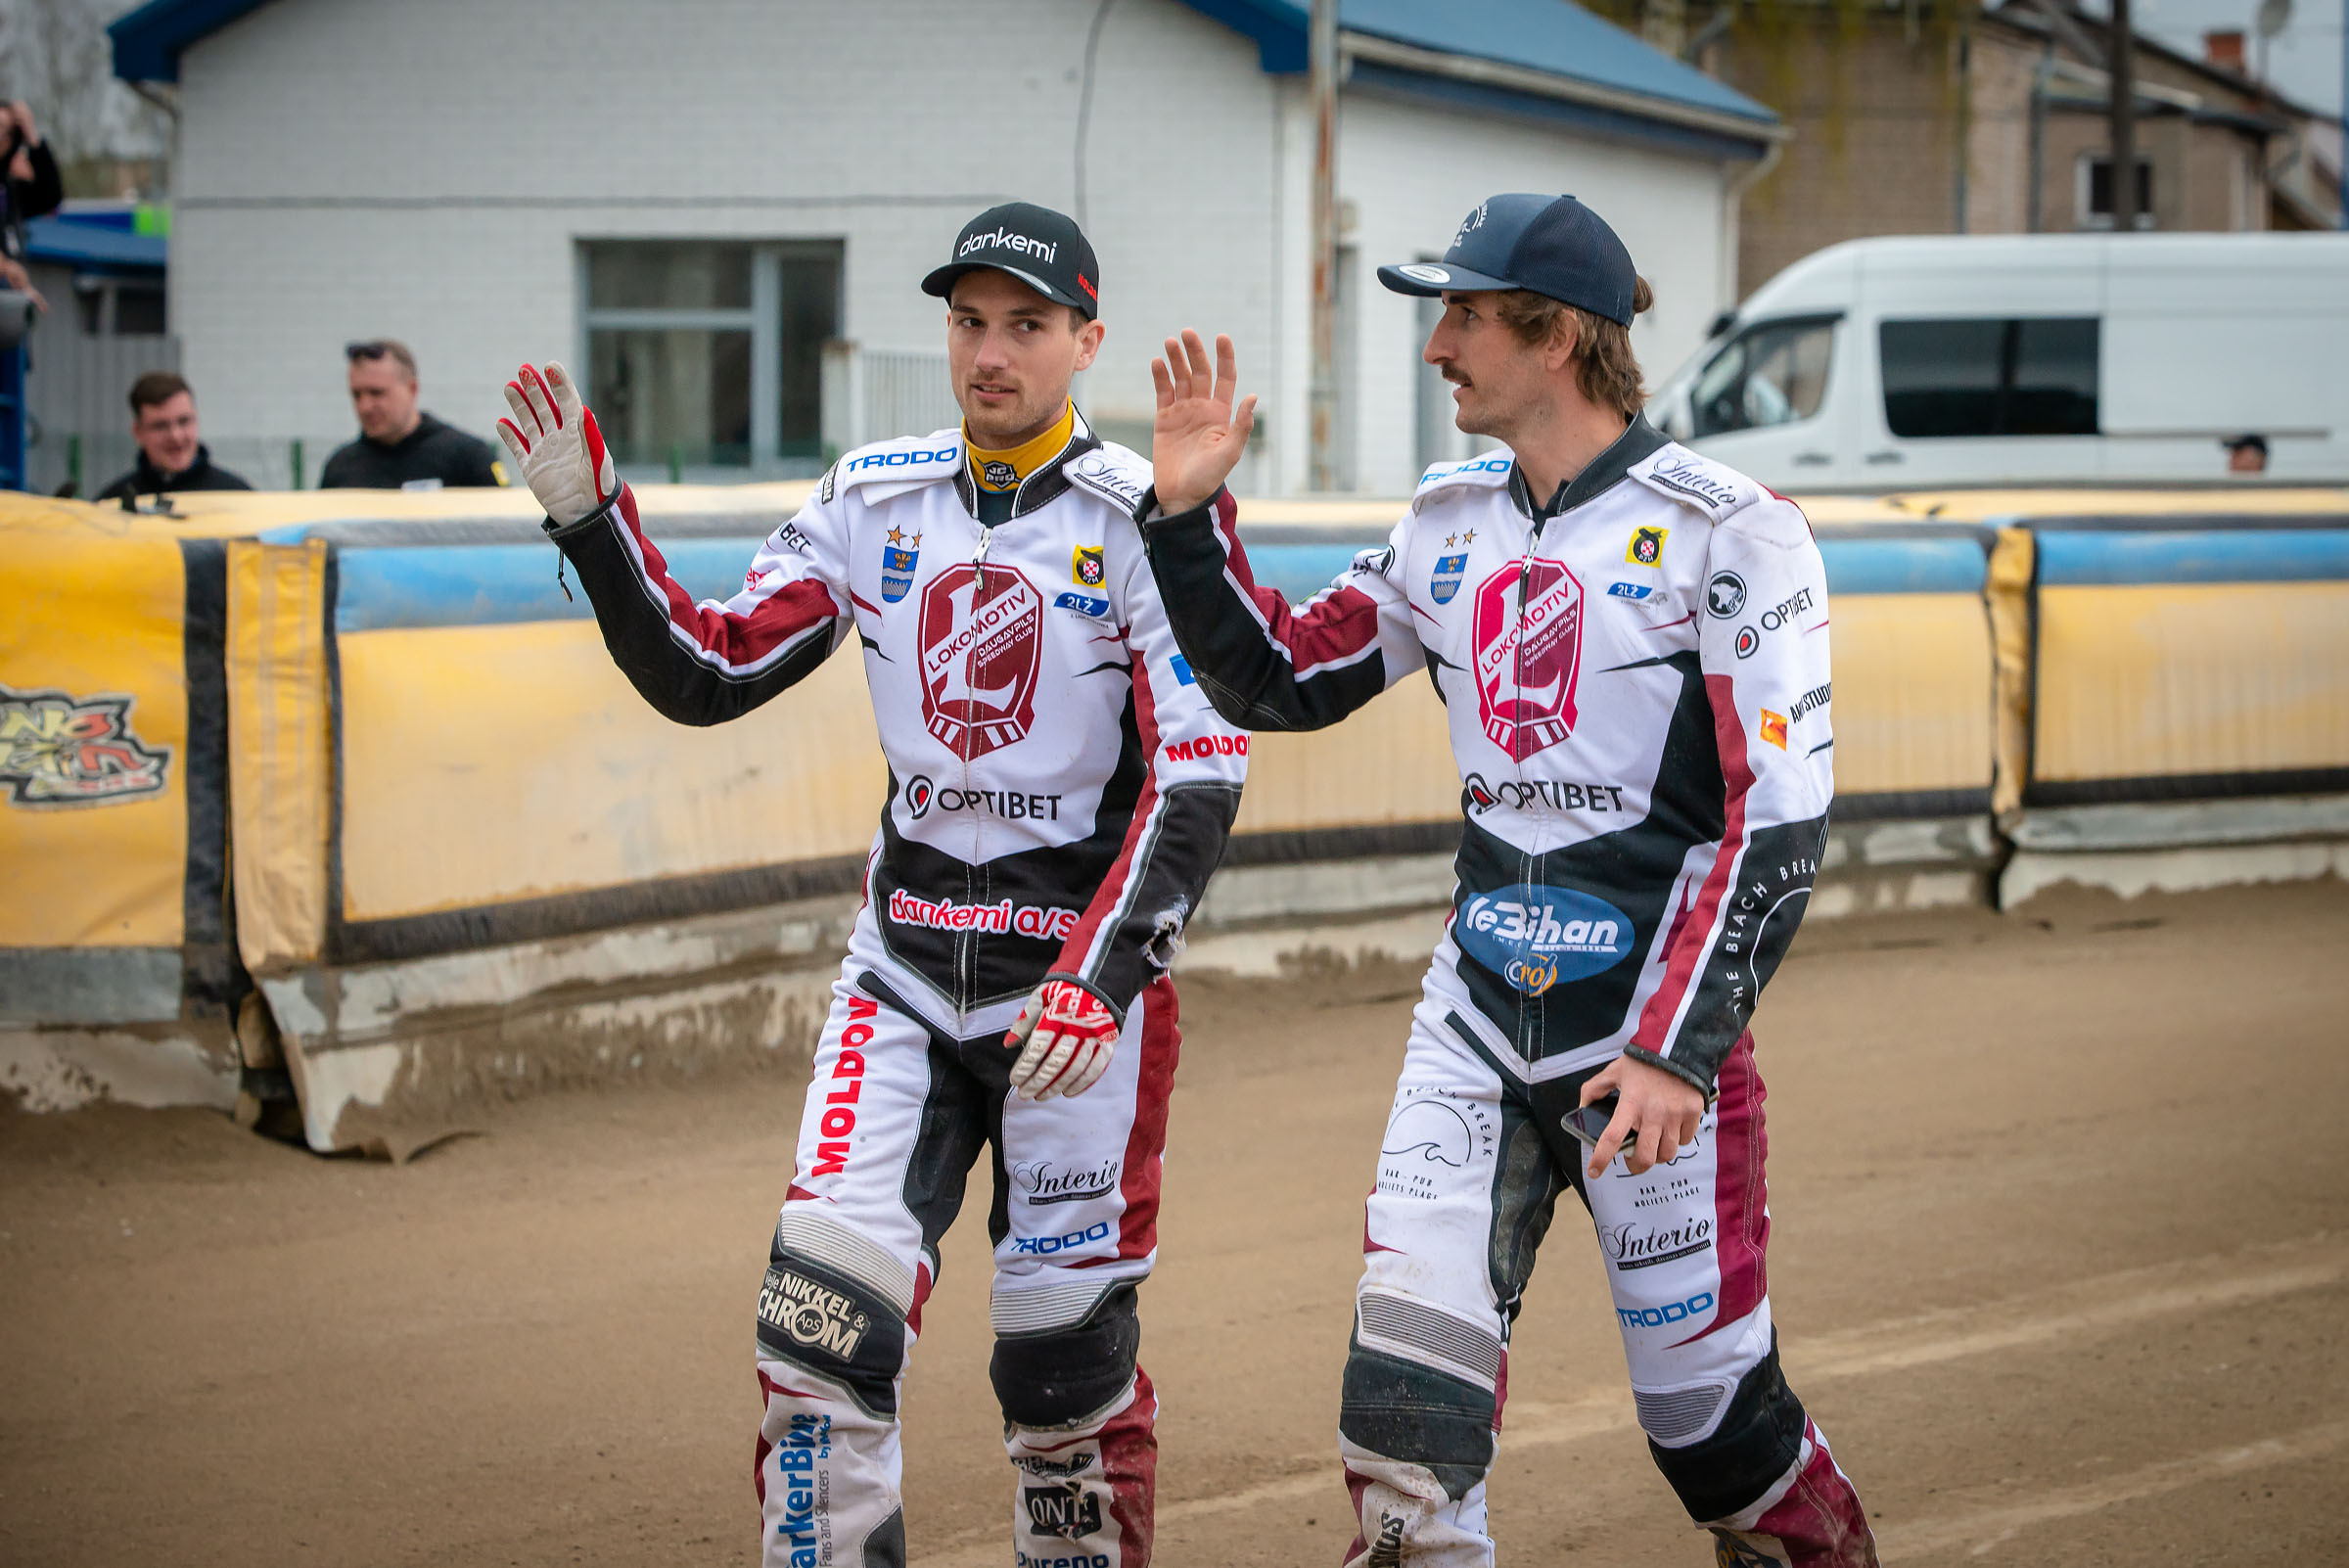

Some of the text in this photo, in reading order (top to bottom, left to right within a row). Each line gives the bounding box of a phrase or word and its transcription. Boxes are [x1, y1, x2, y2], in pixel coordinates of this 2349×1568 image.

[959, 226, 1057, 264] dankemi
[847, 446, 957, 473] TRODO
[928, 587, 1027, 673] LOKOMOTIV
[977, 625, 1035, 669] SPEEDWAY CLUB
[978, 613, 1035, 658] DAUGAVPILS
[1482, 581, 1570, 675] LOKOMOTIV
[1523, 608, 1578, 657] DAUGAVPILS
[1524, 623, 1575, 668] SPEEDWAY CLUB
[1165, 734, 1250, 762] MOLDO
[937, 786, 1062, 821] OPTIBET
[1497, 780, 1624, 812] OPTIBET
[1780, 857, 1818, 882] BREA
[891, 889, 1081, 941] dankemi a/s
[1726, 881, 1768, 953] BEACH
[1466, 1102, 1494, 1158] BREAK
[1013, 1159, 1119, 1194] Interio
[1634, 1194, 1670, 1209] MOLIETS
[1601, 1217, 1714, 1260] Interio
[779, 1271, 851, 1322] NIKKEL
[853, 1314, 865, 1331] &
[796, 1313, 822, 1332] ApS
[1616, 1291, 1714, 1328] TRODO
[758, 1288, 859, 1359] CHROM
[814, 1469, 833, 1568] Fans and Silencers
